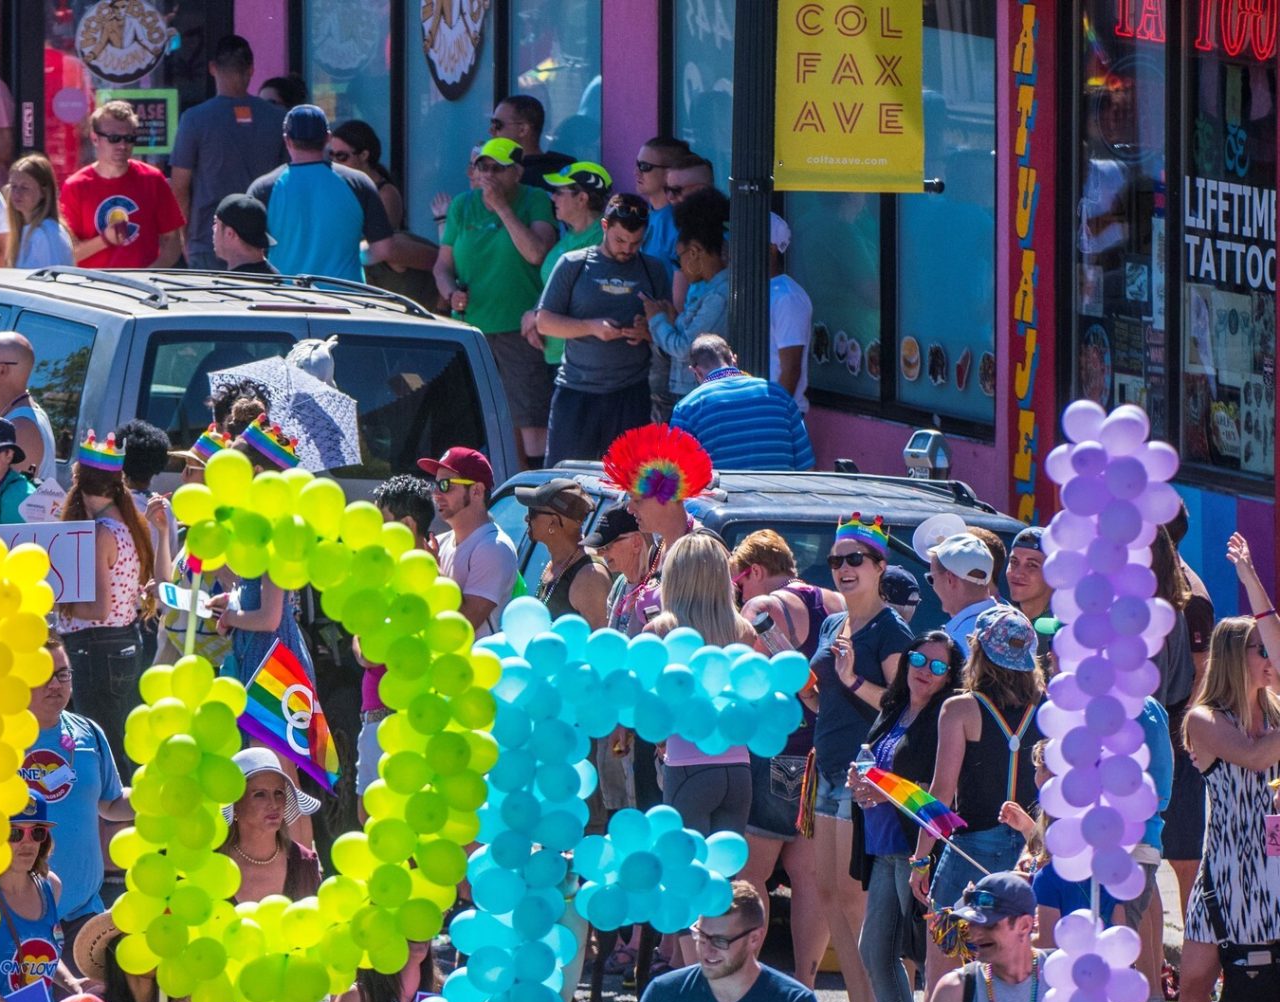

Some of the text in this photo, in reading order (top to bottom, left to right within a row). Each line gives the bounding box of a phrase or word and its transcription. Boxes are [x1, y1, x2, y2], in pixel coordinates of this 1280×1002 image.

[796, 4, 903, 38] COL
[796, 52, 903, 86] FAX
[793, 101, 903, 134] AVE
[806, 155, 888, 166] colfaxave.com
